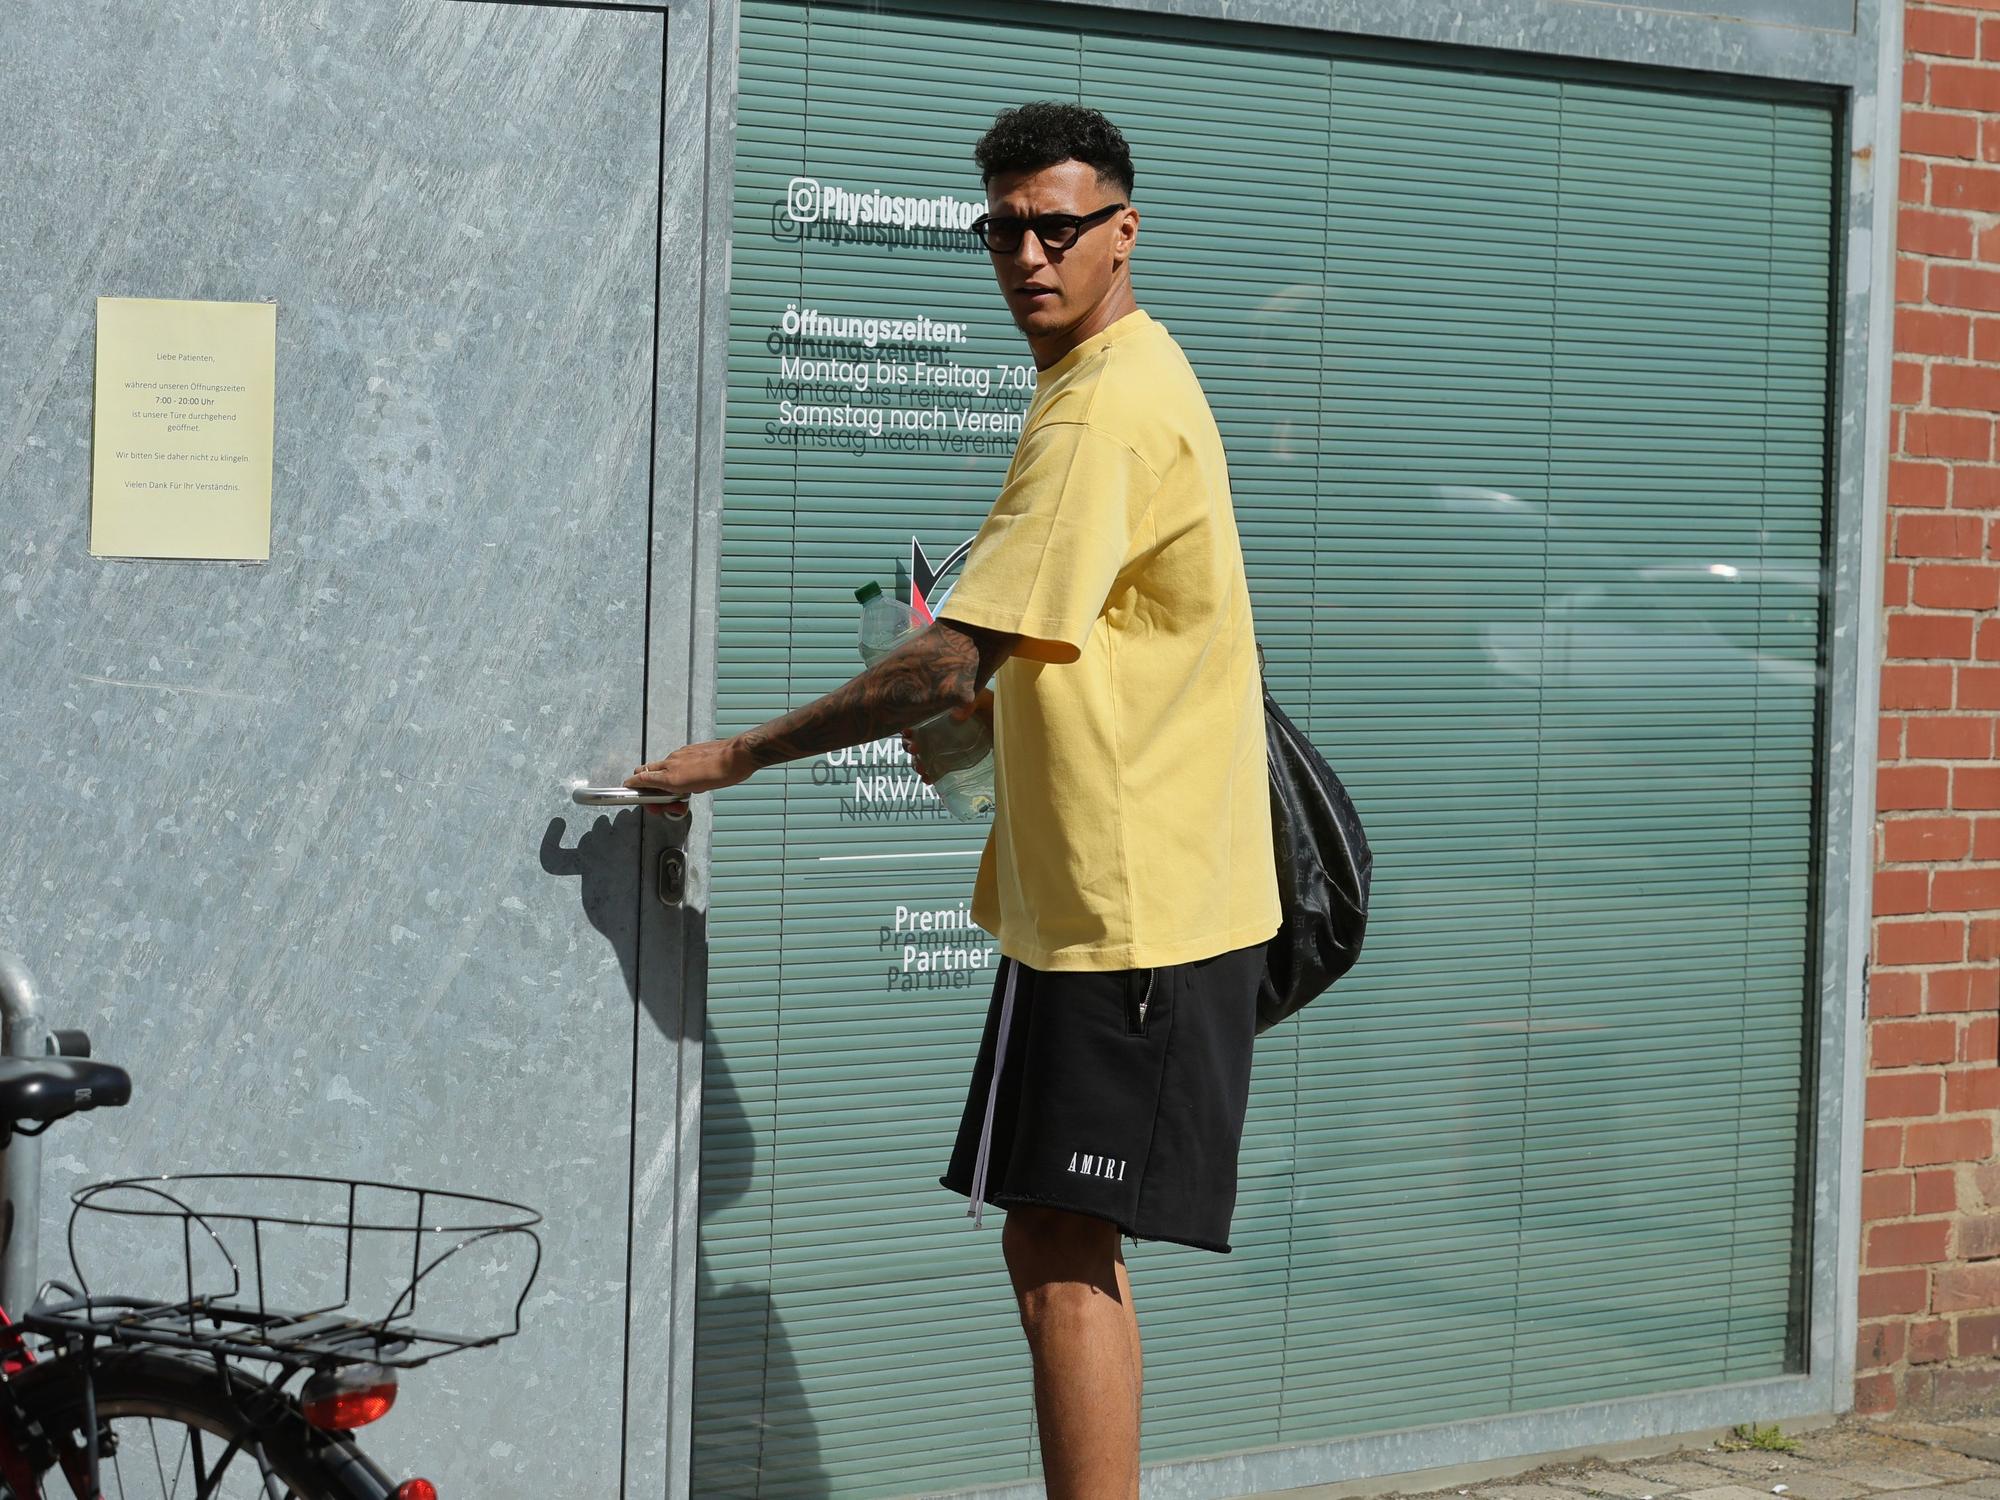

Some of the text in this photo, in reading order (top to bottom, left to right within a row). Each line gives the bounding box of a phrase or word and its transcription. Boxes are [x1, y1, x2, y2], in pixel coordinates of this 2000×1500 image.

[782, 303, 967, 347] Öffnungszeiten:
[156, 353, 215, 364] Liebe Patienten,
[780, 355, 869, 392] Montag
[876, 358, 908, 386] bis
[914, 361, 990, 397] Freitag
[124, 381, 246, 392] während unseren Öffnungszeiten
[155, 396, 172, 404] 7:00
[178, 397, 200, 405] 20:00
[201, 398, 215, 406] Uhr
[170, 411, 187, 419] Türe
[188, 412, 237, 421] durchgehend
[779, 400, 883, 436] Samstag
[889, 405, 946, 431] nach
[167, 423, 201, 432] geöffnet.
[115, 451, 129, 459] Wir
[130, 451, 153, 460] bitten
[154, 452, 166, 460] Sie
[167, 453, 189, 461] daher
[190, 453, 209, 461] nicht
[124, 480, 241, 491] Vielen Dank Für Ihr Verständnis.
[895, 901, 979, 933] Premiu
[903, 945, 994, 973] Partner
[1067, 1151, 1127, 1181] AMIRI
